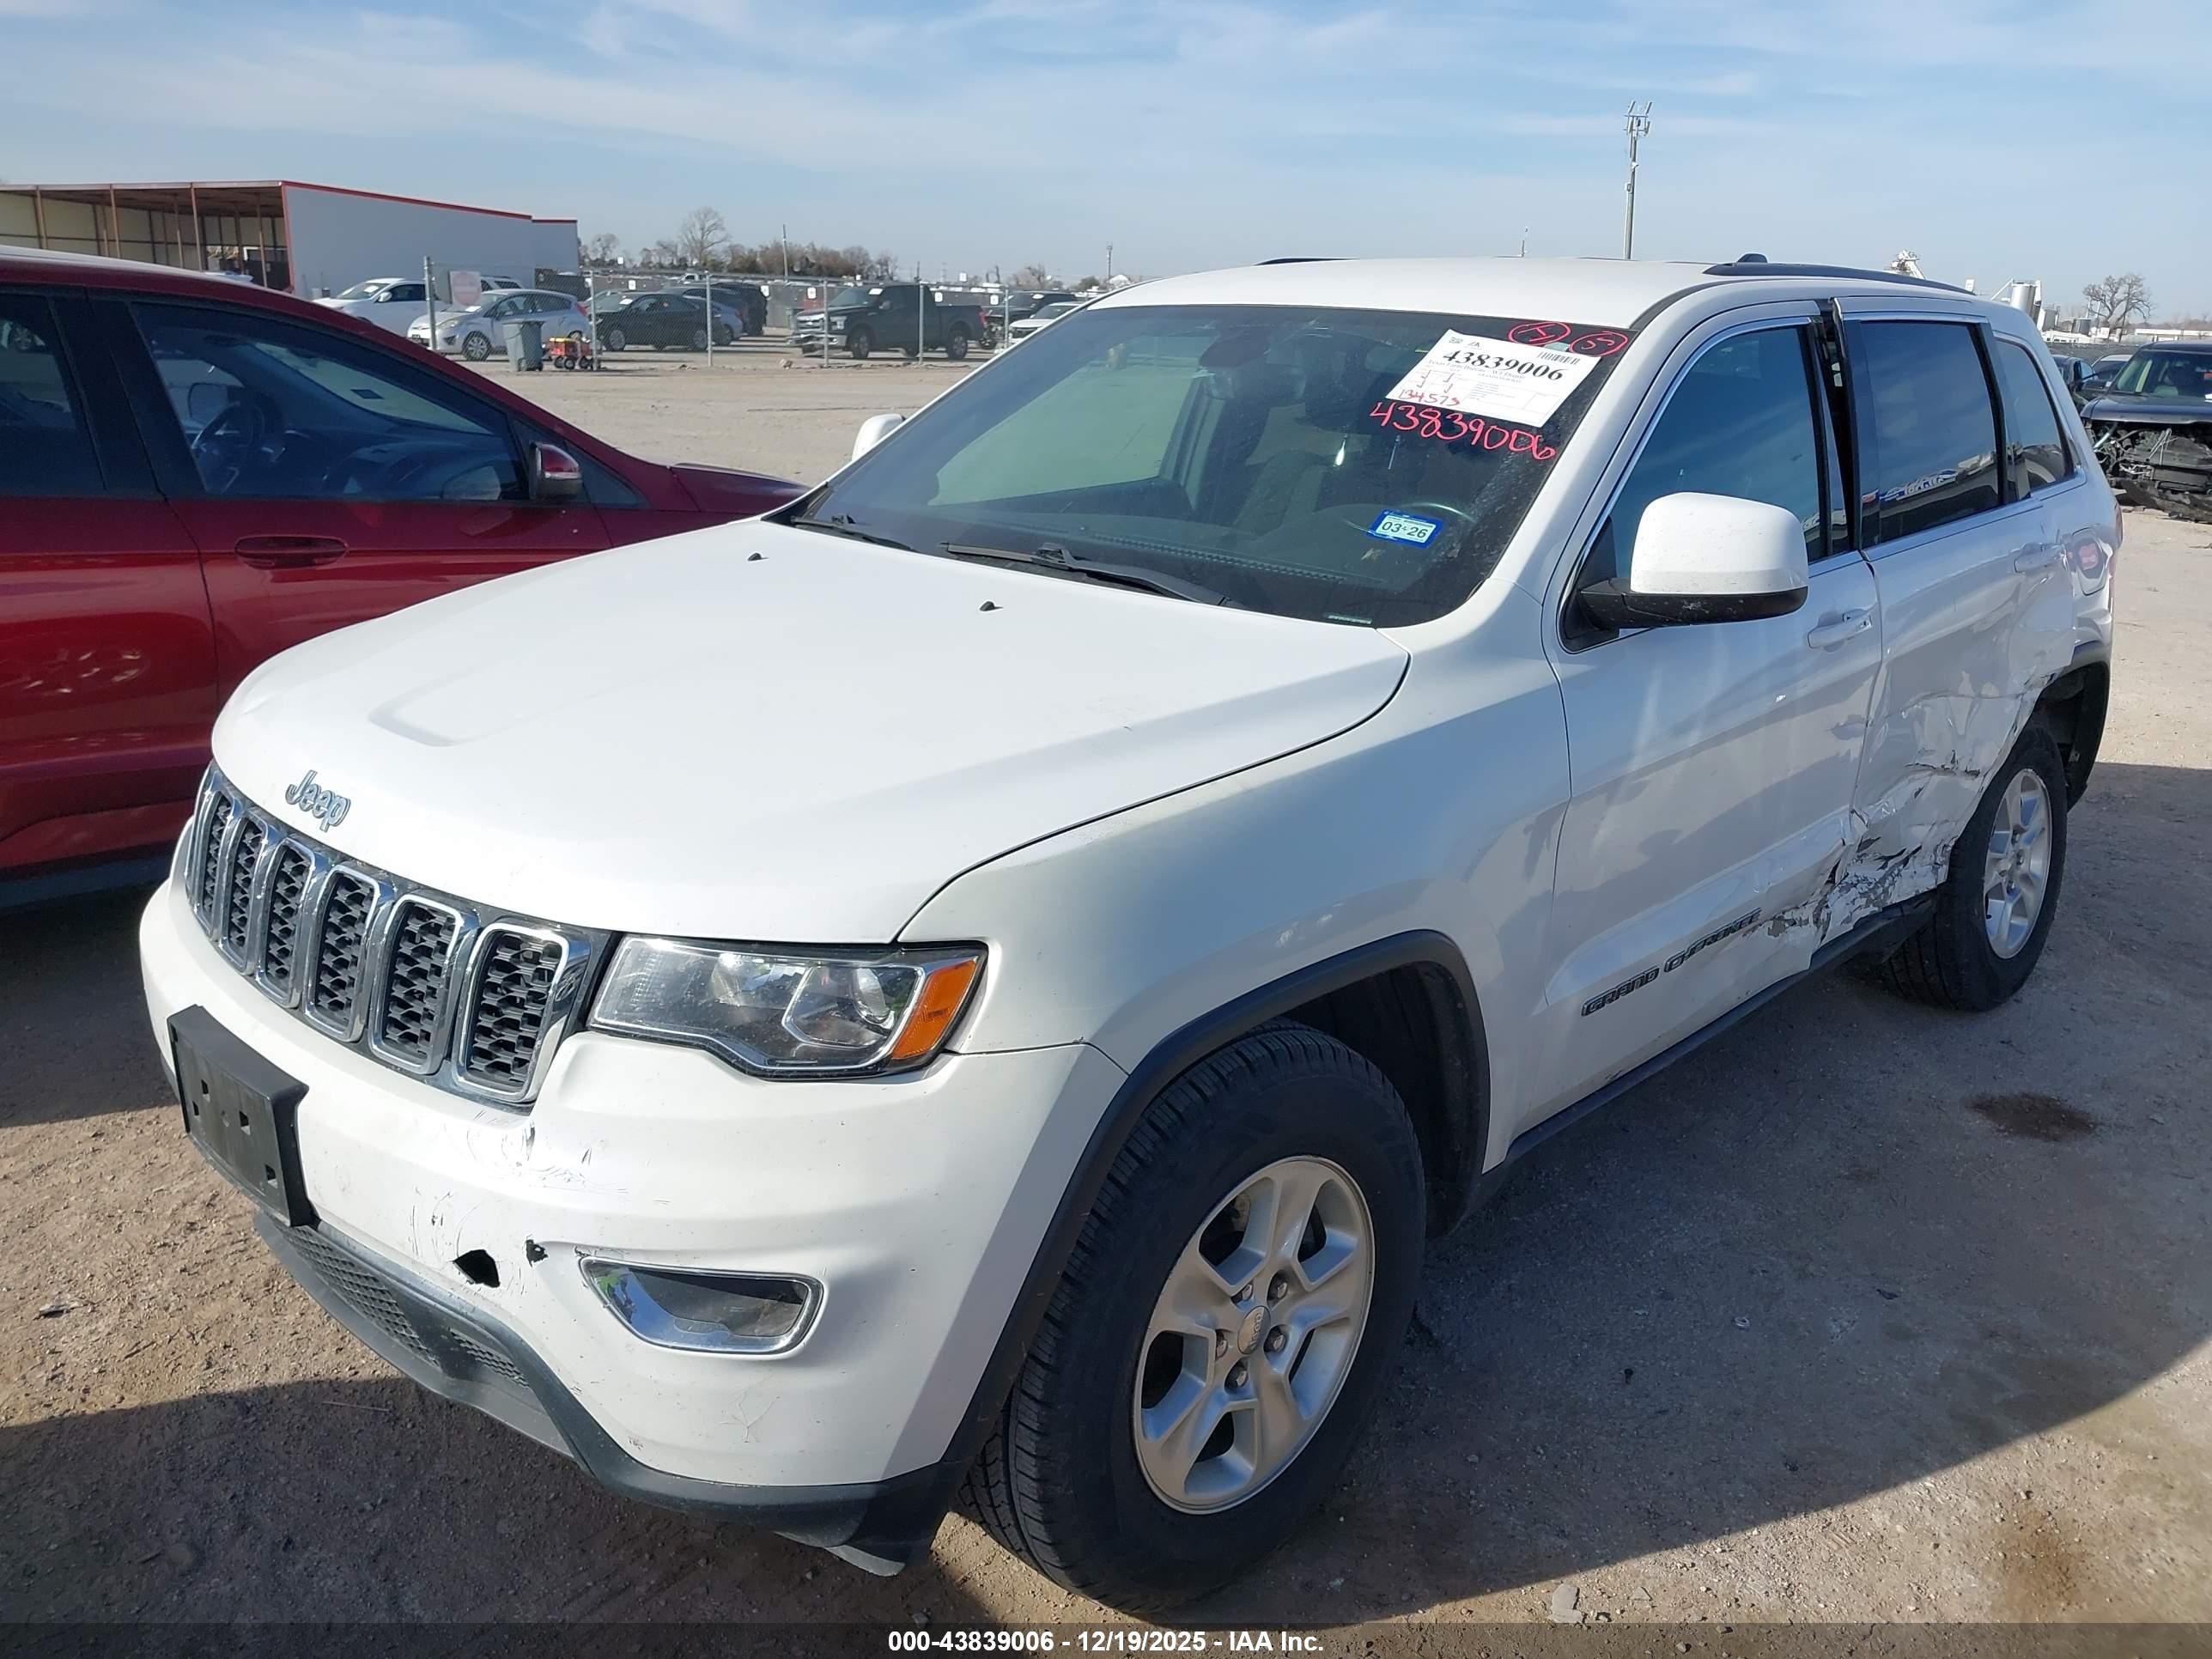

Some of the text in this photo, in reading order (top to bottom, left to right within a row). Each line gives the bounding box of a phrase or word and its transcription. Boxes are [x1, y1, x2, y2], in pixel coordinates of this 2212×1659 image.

[1443, 350, 1564, 380] 43839006
[1369, 401, 1556, 459] 43839006
[285, 769, 351, 833] Jeep
[1581, 964, 1660, 1017] GRAND
